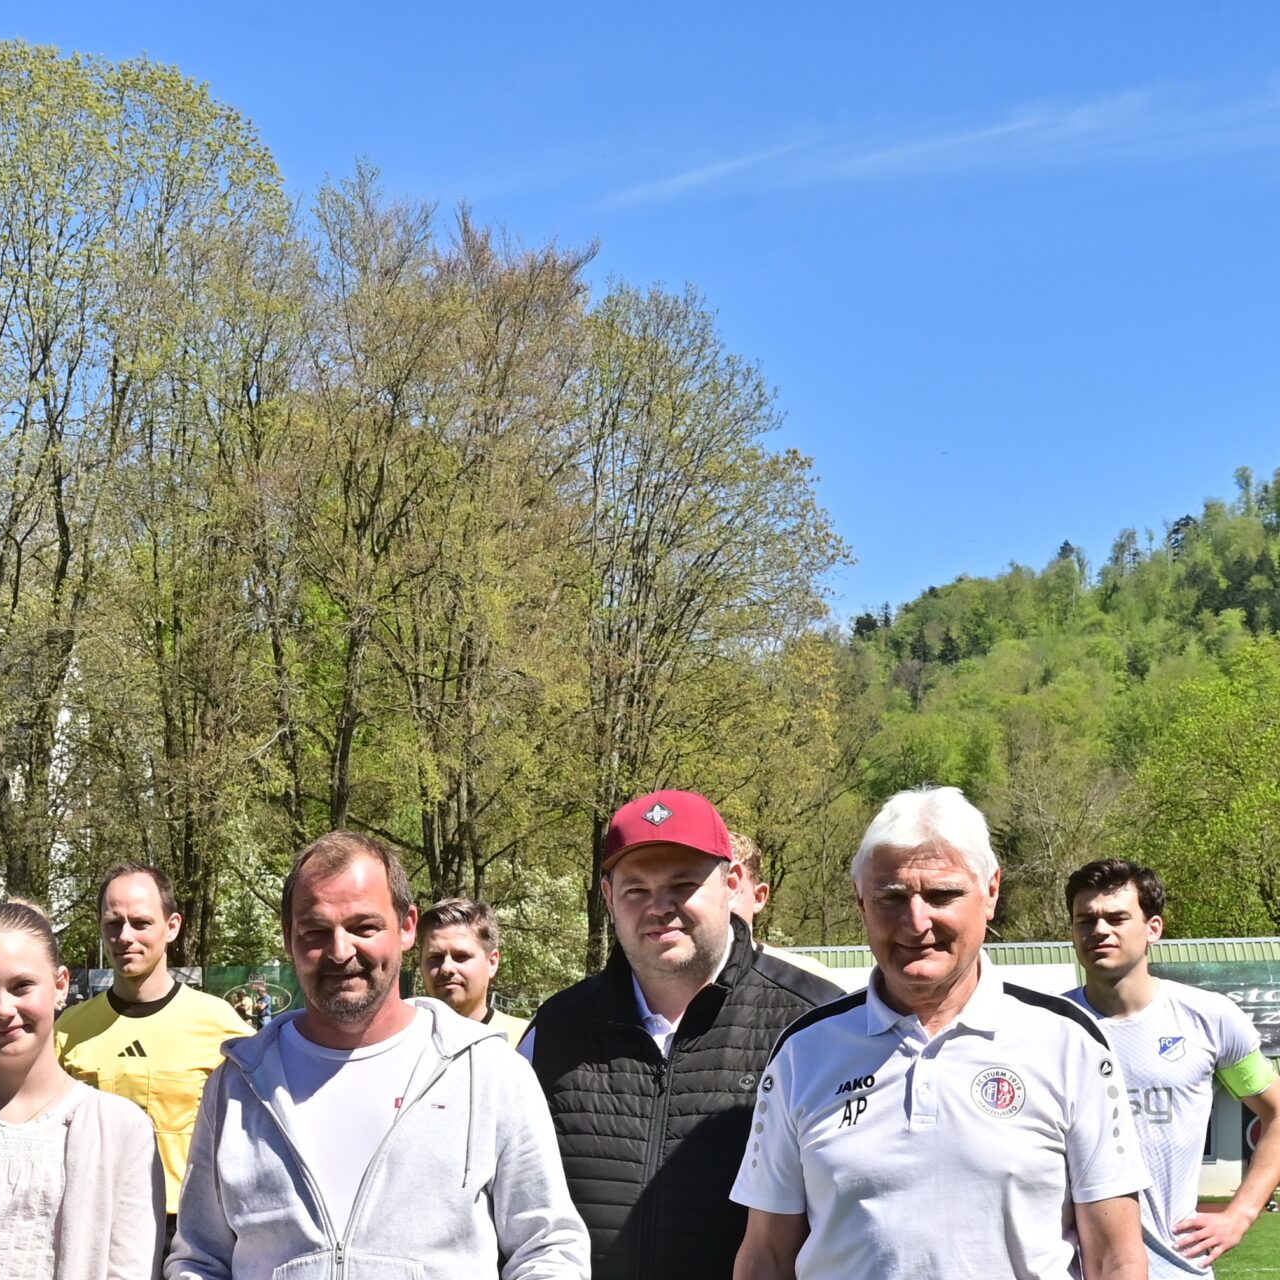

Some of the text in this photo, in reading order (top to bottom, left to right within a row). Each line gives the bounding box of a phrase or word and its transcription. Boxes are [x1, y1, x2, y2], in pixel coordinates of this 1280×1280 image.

[1160, 1038, 1173, 1048] FC
[983, 1071, 1006, 1080] STURM
[835, 1074, 875, 1095] JAKO
[838, 1096, 868, 1129] AP
